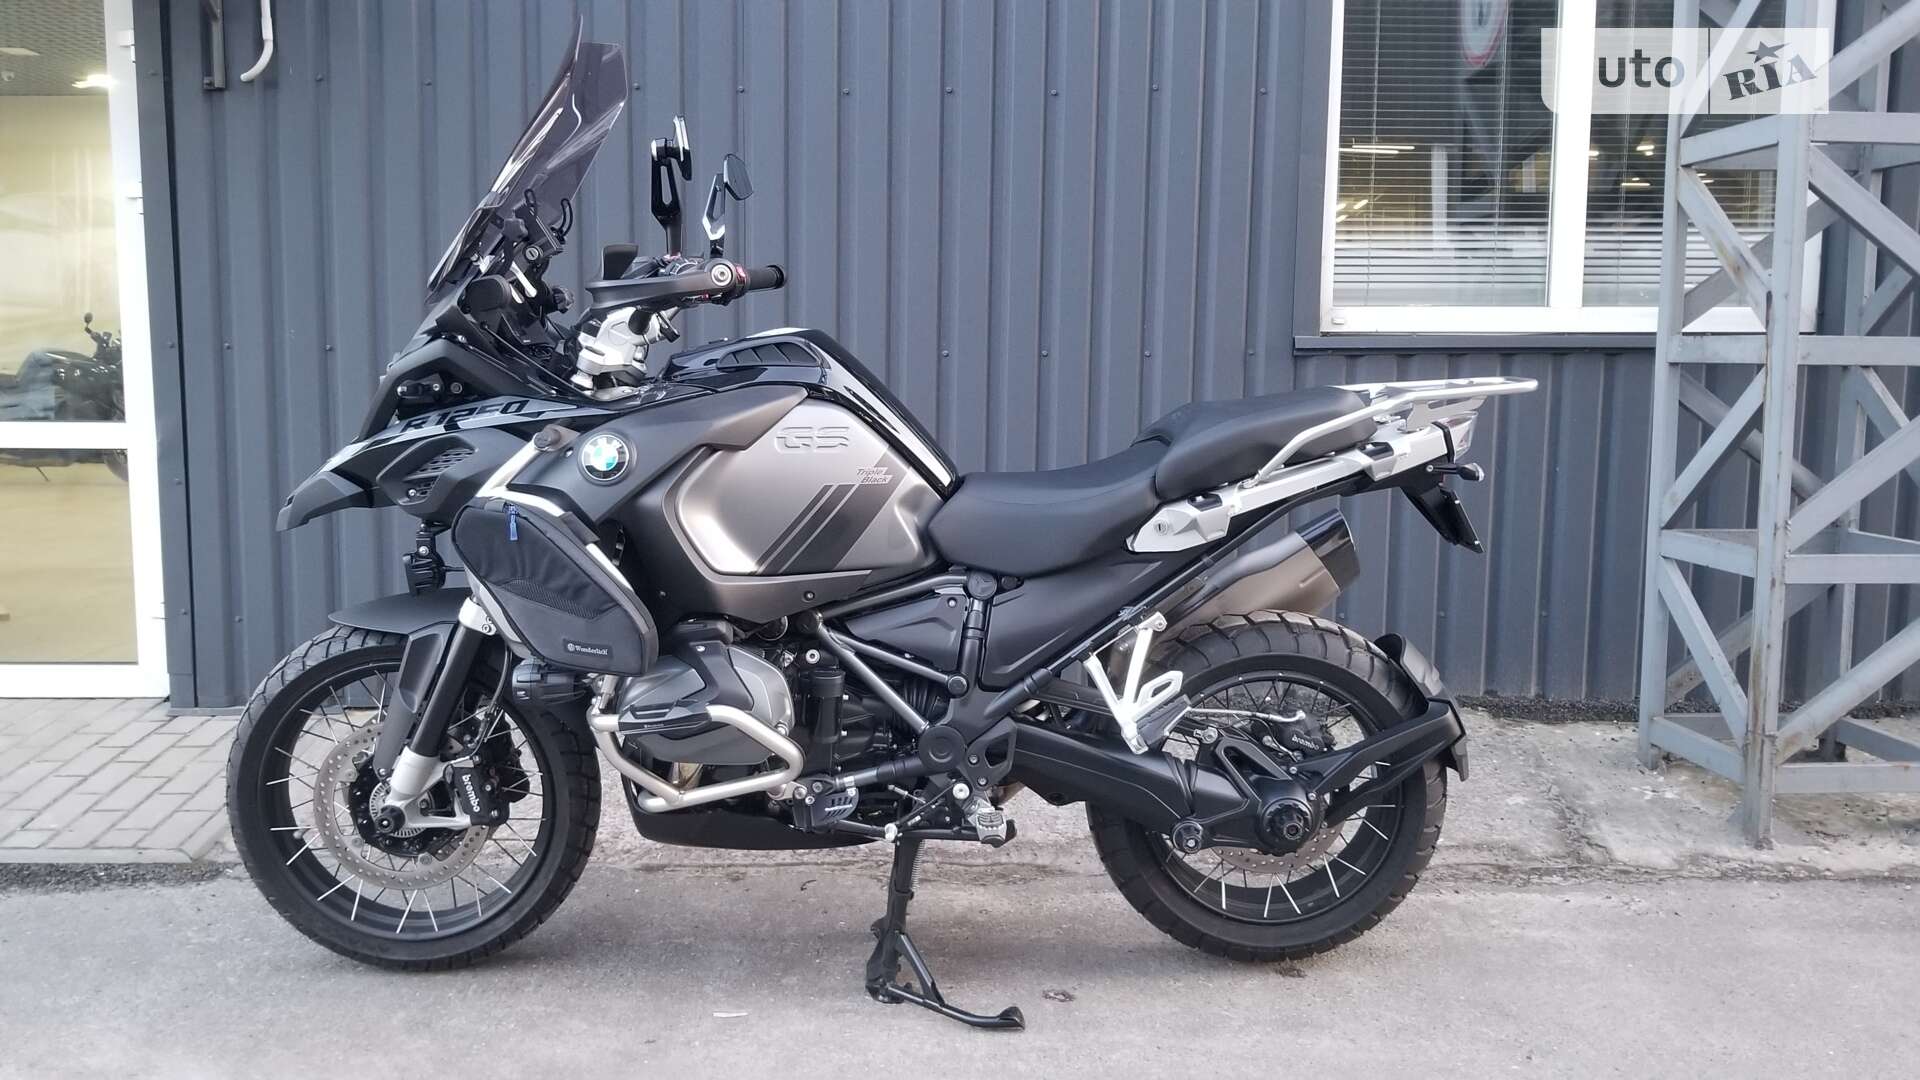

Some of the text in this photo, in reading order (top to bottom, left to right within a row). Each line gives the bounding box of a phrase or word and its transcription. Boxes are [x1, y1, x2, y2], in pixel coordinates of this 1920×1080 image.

[775, 426, 849, 454] GS
[857, 468, 885, 477] Triple
[462, 774, 480, 812] brembo
